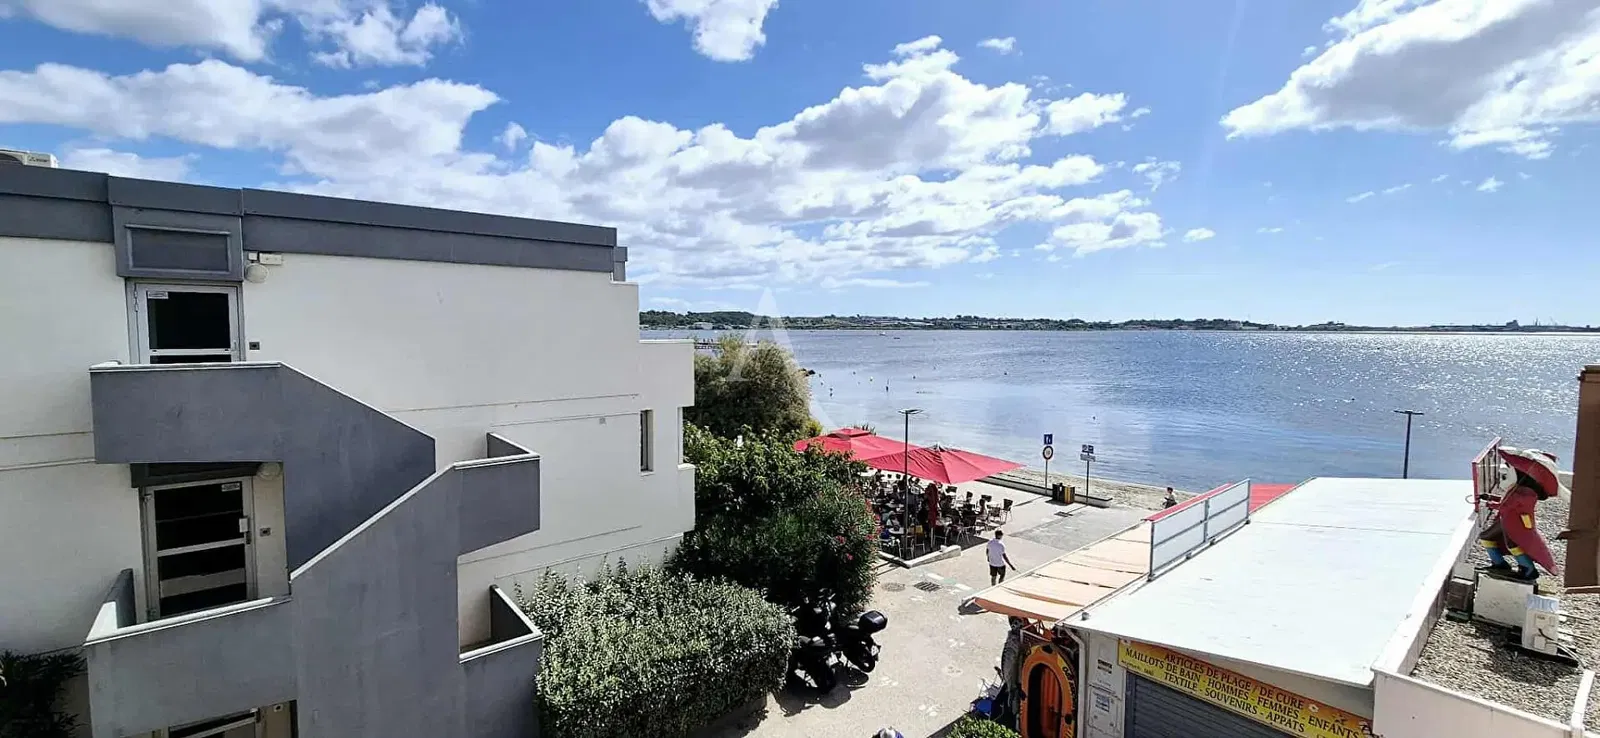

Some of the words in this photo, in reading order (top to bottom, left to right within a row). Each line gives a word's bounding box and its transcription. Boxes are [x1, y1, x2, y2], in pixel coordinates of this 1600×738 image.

[1126, 648, 1164, 669] MAILLOTS
[1166, 663, 1178, 674] DE
[1179, 669, 1201, 683] BAIN
[1208, 679, 1249, 700] HOMMES
[1257, 697, 1299, 719] FEMMES
[1308, 715, 1360, 738] ENFANTS
[1164, 653, 1204, 673] ARTICLES
[1206, 667, 1219, 678] DE
[1221, 673, 1251, 690] PLAGE
[1260, 686, 1273, 698] DE
[1276, 692, 1304, 710] CURE
[1164, 672, 1198, 691] TEXTILE
[1204, 688, 1258, 715] SOUVENIRS
[1265, 712, 1305, 733] APPATS
